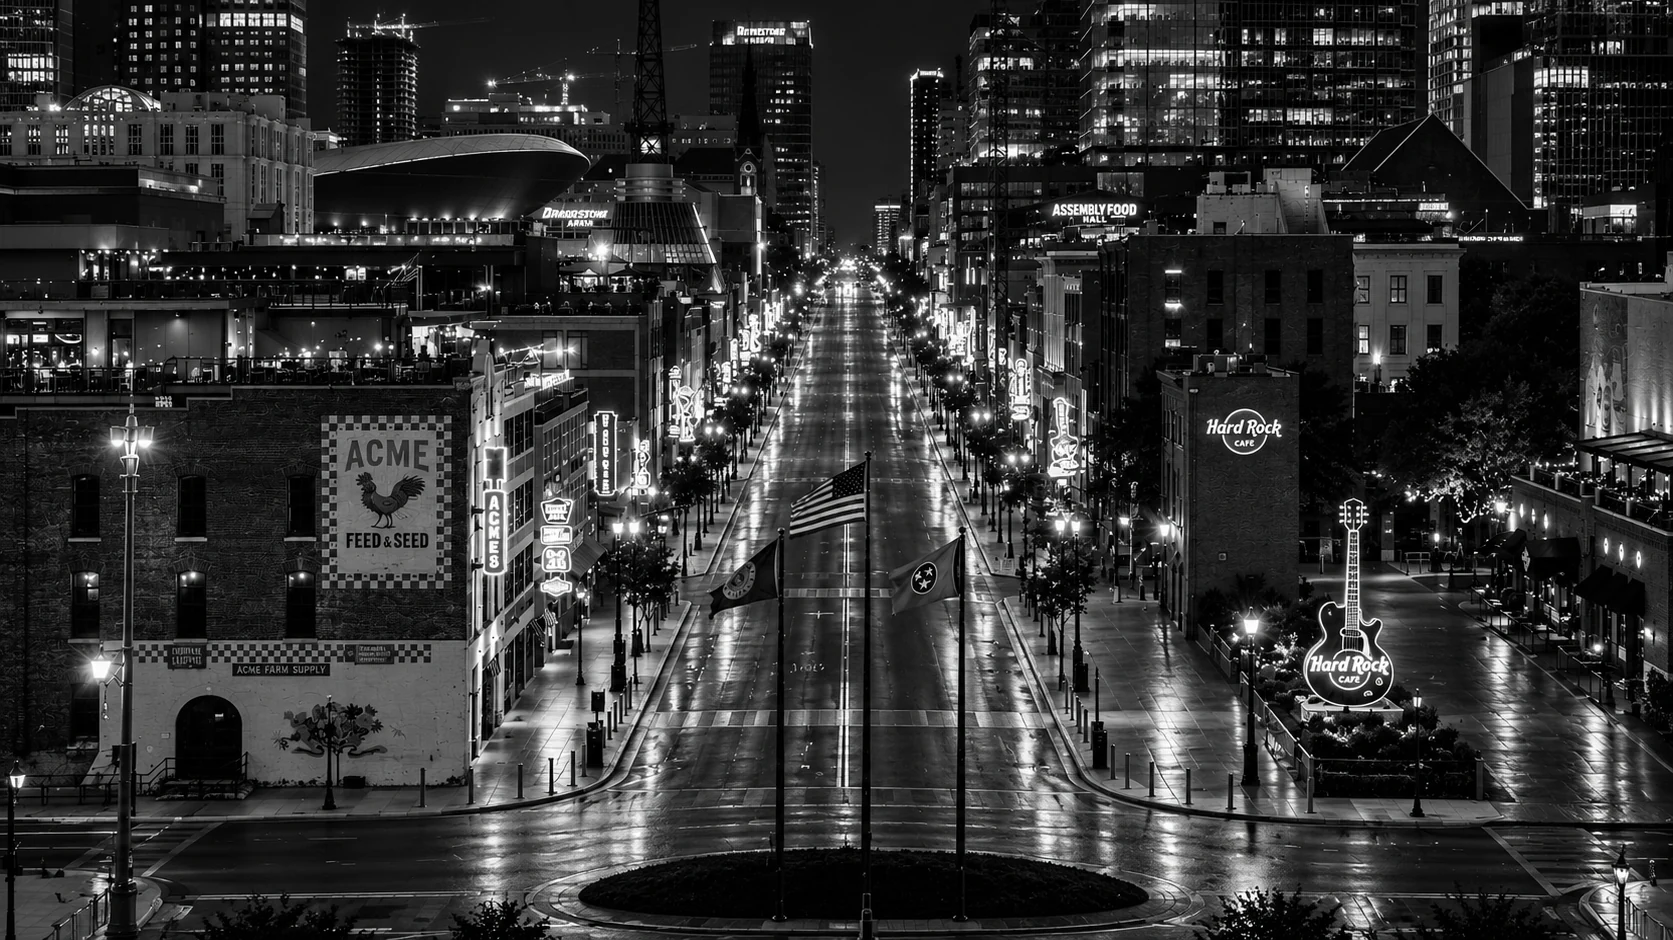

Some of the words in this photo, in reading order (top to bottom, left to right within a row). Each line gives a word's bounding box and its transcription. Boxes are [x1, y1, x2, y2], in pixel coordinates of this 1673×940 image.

[1052, 203, 1106, 216] ASSEMBLY
[1107, 203, 1137, 216] FOOD
[1082, 215, 1107, 223] HALL
[1206, 418, 1245, 435] Hard
[1246, 419, 1282, 437] Rock
[1234, 439, 1255, 447] CAFE
[345, 439, 429, 473] ACME
[346, 532, 382, 549] FEED
[383, 535, 392, 548] &
[393, 532, 429, 549] SEED
[236, 665, 261, 675] ACME
[264, 665, 289, 675] FARM
[292, 665, 326, 675] SUPPLY
[1309, 655, 1350, 672] Hard
[1351, 655, 1389, 675] Rock
